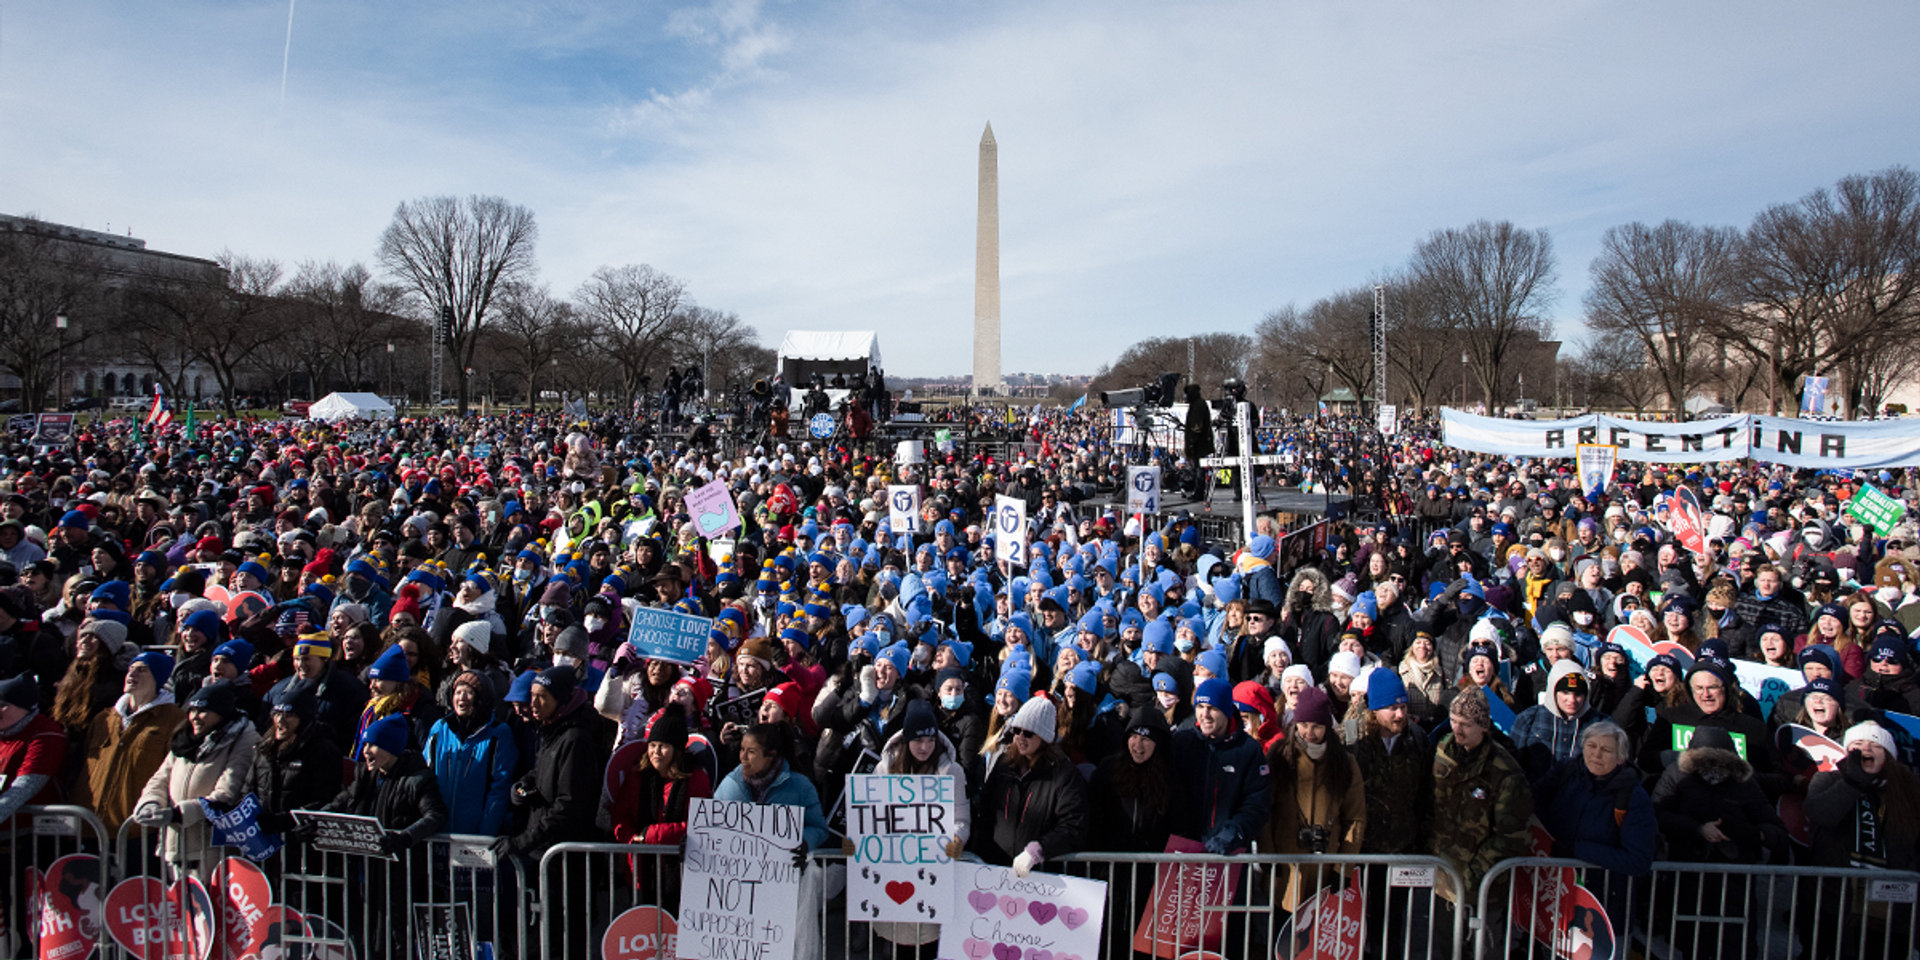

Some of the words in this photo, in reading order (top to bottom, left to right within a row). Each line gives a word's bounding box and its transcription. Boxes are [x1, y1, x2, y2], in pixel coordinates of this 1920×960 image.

[1145, 496, 1155, 511] 4
[907, 517, 915, 530] 1
[1010, 541, 1020, 561] 2
[636, 611, 678, 631] CHOOSE
[680, 619, 708, 636] LOVE
[633, 627, 675, 648] CHOOSE
[677, 635, 700, 652] LIFE
[921, 776, 953, 803] BE
[693, 799, 799, 842] ABORTION
[851, 803, 946, 834] THEIR
[848, 834, 952, 865] VOICES
[974, 866, 1066, 896] Choose
[706, 877, 762, 915] NOT
[976, 894, 1078, 925] LOVE
[120, 901, 177, 924] LOVE
[619, 933, 678, 955] LOVE
[970, 916, 1056, 949] Choose
